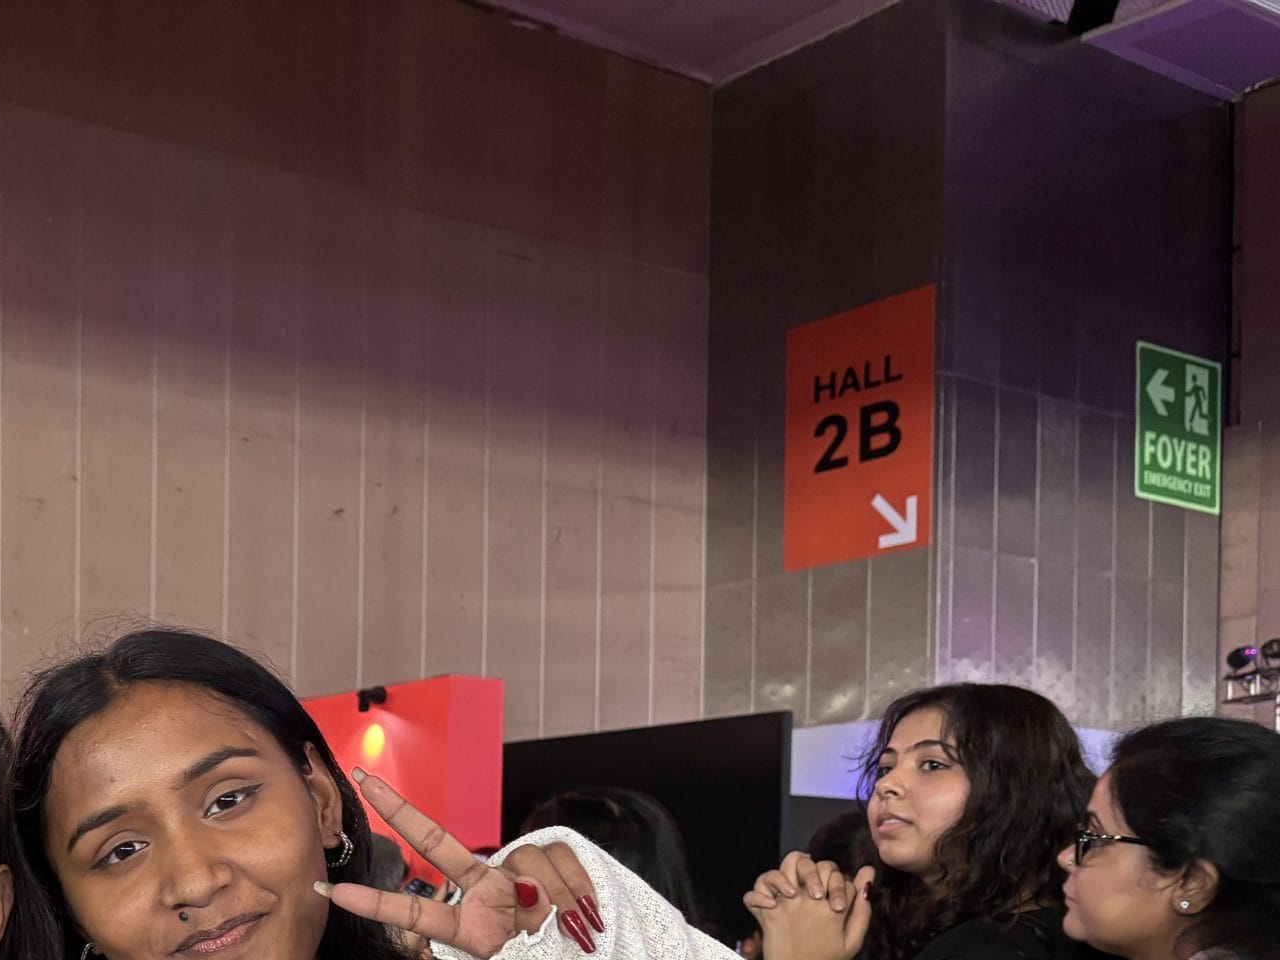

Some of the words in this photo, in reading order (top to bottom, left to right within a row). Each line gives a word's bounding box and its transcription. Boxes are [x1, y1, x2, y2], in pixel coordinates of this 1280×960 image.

[813, 355, 904, 404] HALL
[813, 400, 903, 475] 2B
[1144, 430, 1212, 480] FOYER
[1143, 470, 1193, 495] EMERGENCY
[1194, 481, 1212, 498] EXIT
